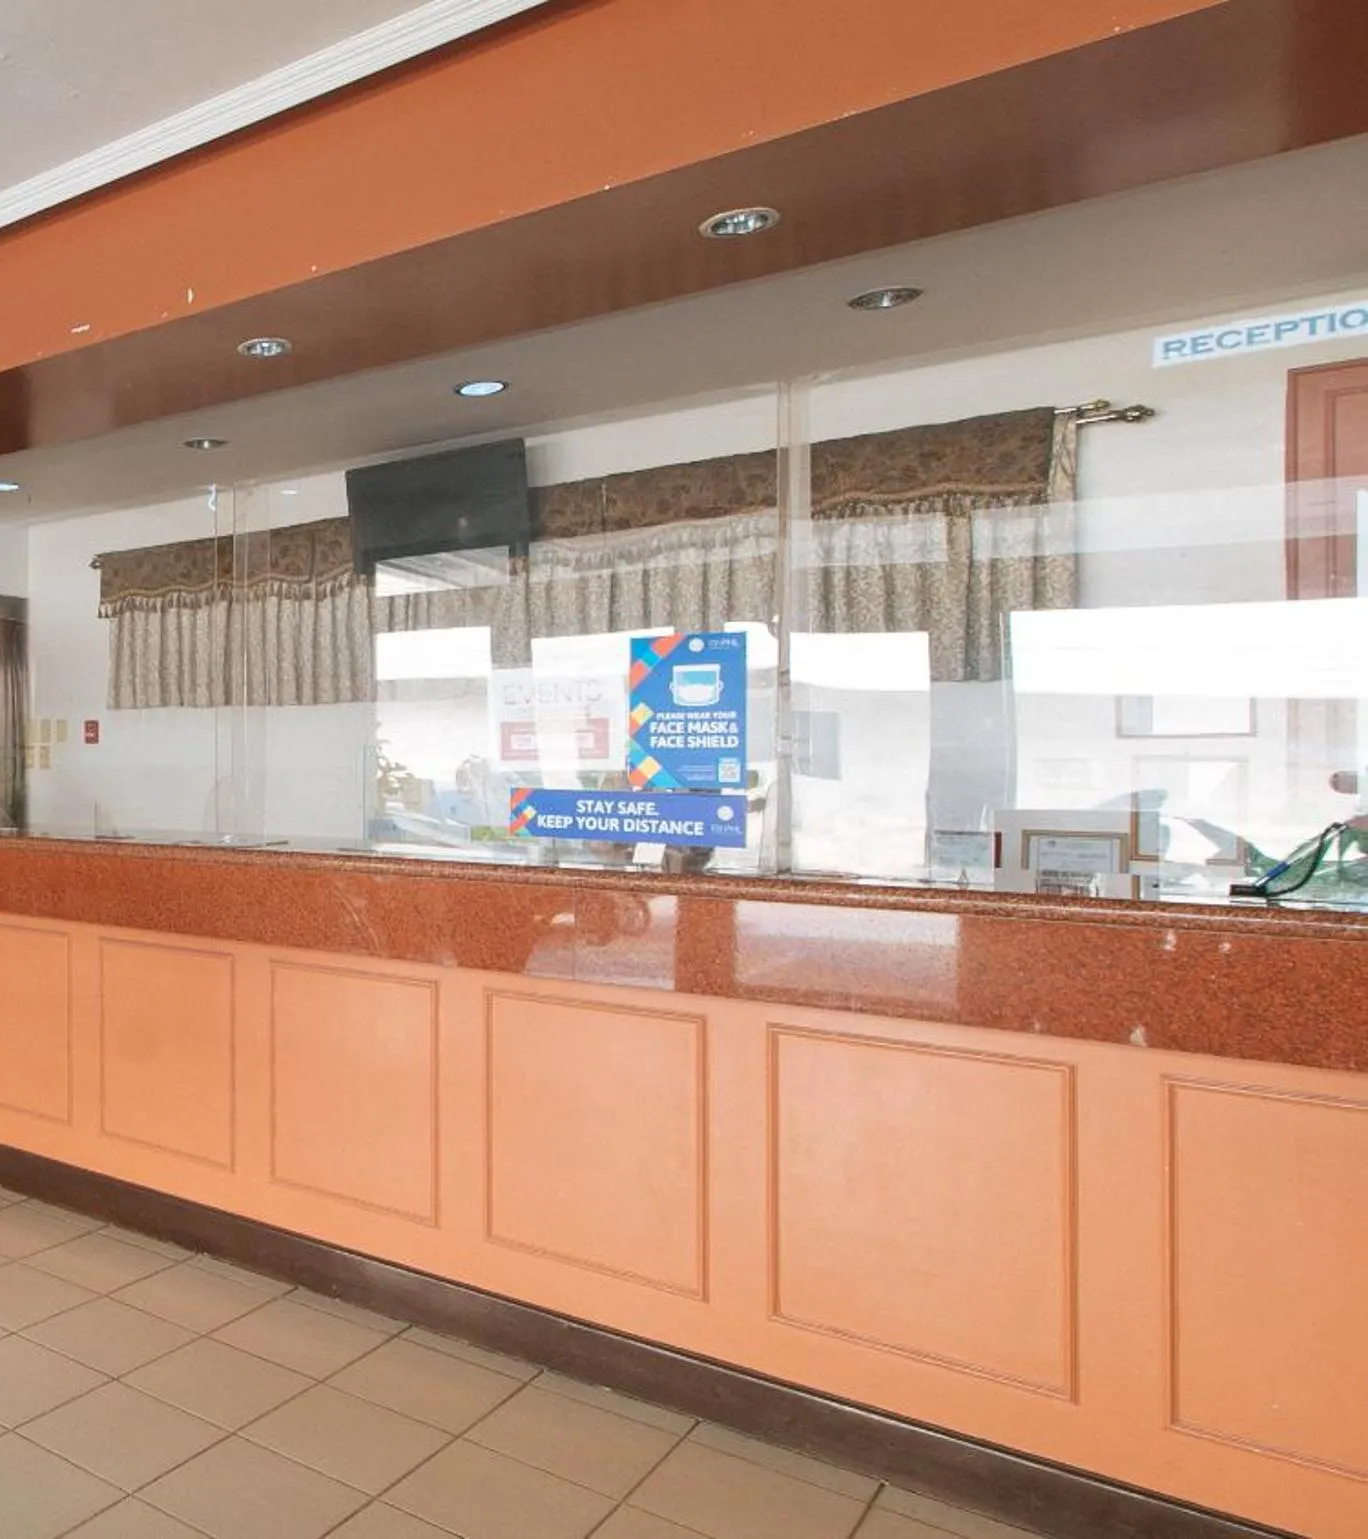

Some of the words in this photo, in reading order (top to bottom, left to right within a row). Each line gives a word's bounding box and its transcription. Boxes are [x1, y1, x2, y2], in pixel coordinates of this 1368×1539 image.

[1163, 308, 1368, 359] RECEPTIO
[650, 722, 684, 733] FACE
[688, 722, 728, 733] MASK
[651, 736, 685, 748] FACE
[687, 736, 739, 748] SHIELD
[576, 800, 613, 815] STAY
[618, 802, 659, 816] SAFE.
[537, 815, 573, 829] KEEP
[576, 817, 619, 832] YOUR
[624, 819, 704, 836] DISTANCE
